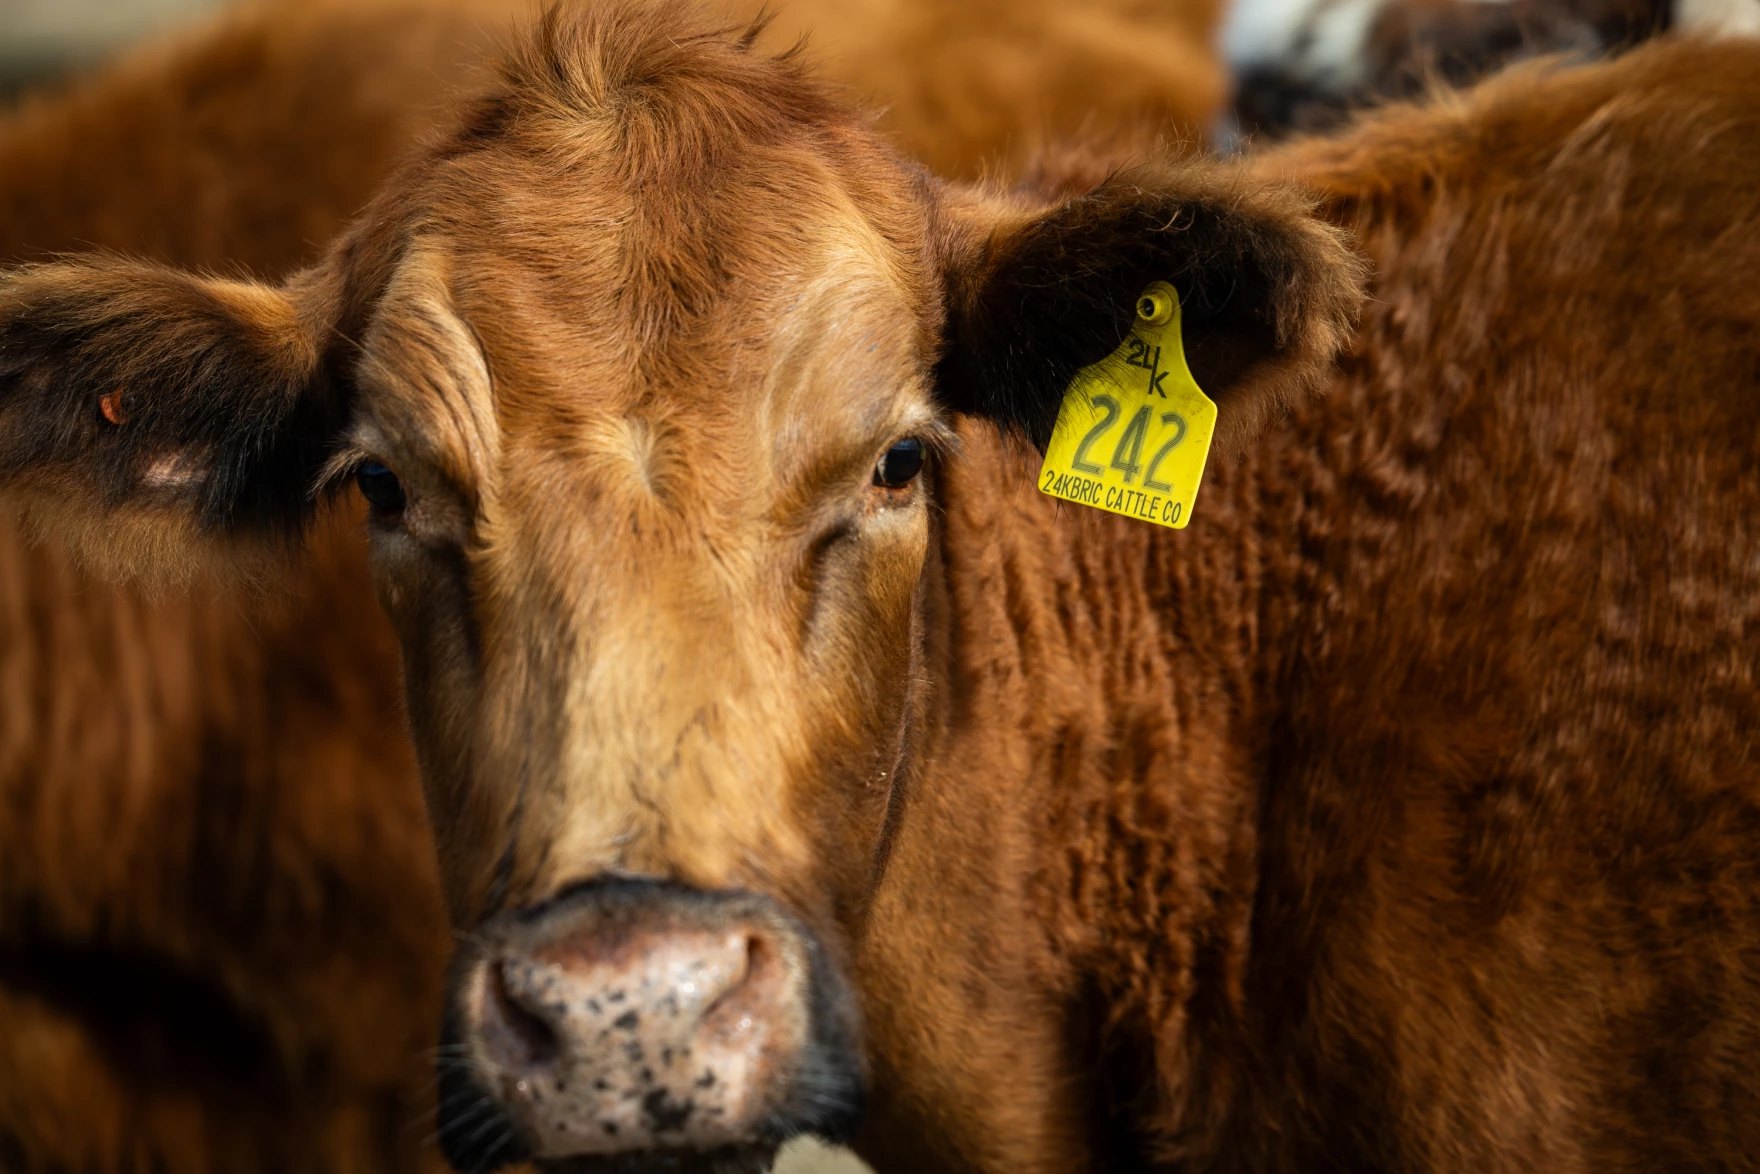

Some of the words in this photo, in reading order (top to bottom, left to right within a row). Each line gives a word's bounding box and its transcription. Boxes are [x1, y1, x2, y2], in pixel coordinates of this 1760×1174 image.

[1071, 394, 1189, 494] 242
[1042, 470, 1103, 505] 24KBRIC
[1105, 486, 1161, 520] CATTLE
[1162, 499, 1182, 525] CO
